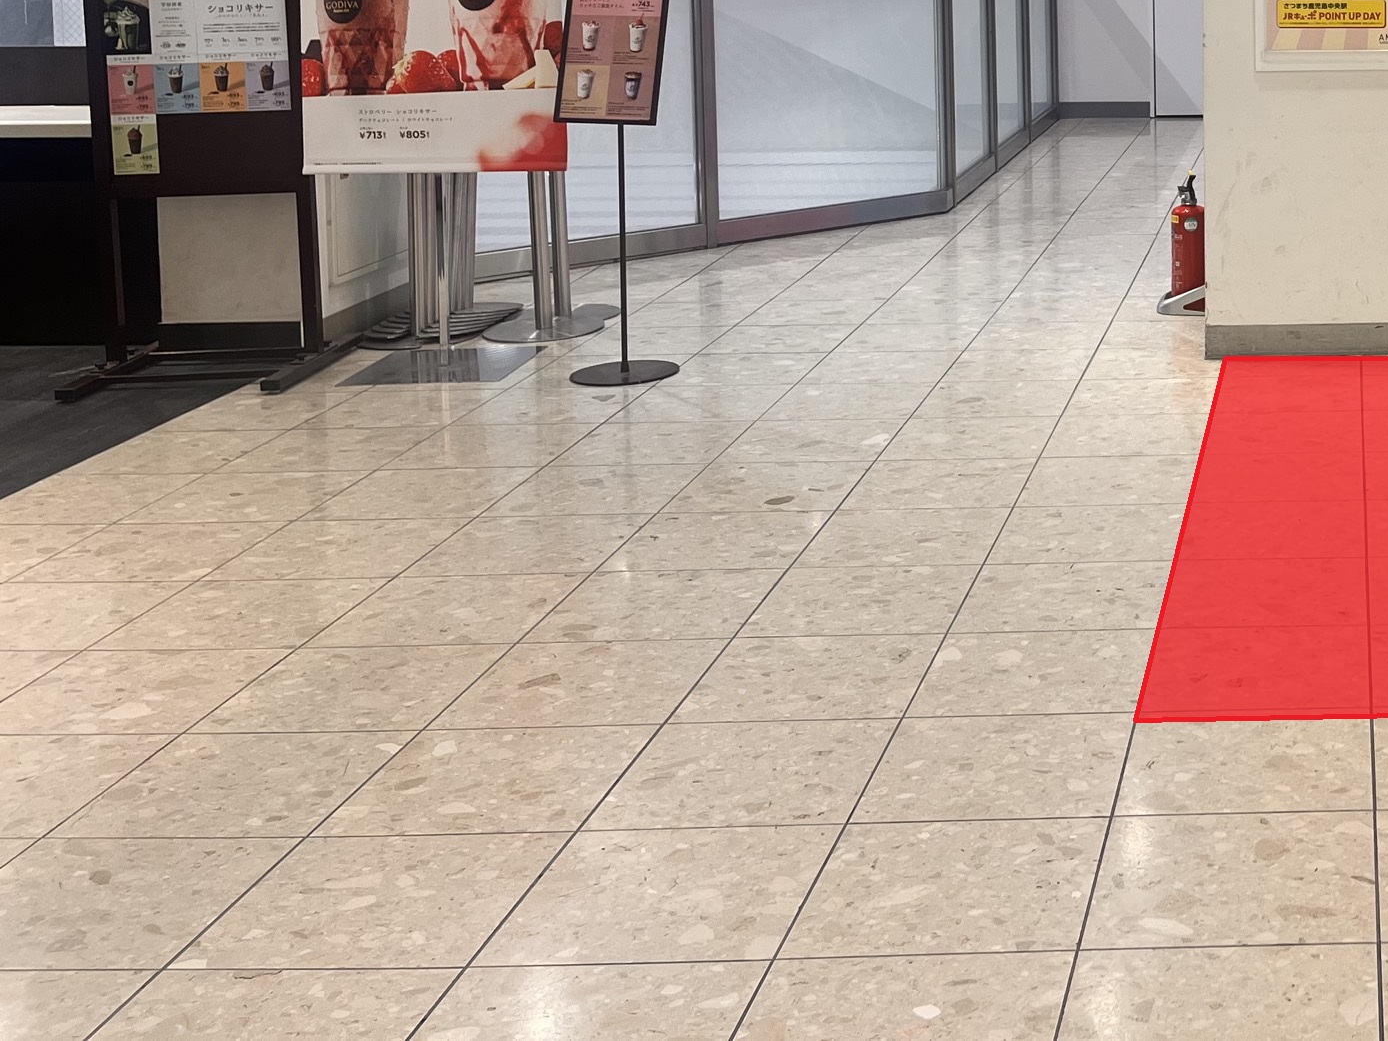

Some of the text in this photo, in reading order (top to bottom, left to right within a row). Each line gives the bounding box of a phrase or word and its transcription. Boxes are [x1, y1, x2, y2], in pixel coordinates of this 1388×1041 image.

[207, 3, 274, 14] ショコリキサー
[325, 1, 359, 10] GODIVA
[1318, 12, 1348, 21] POINT
[1348, 12, 1361, 21] UP
[1362, 12, 1382, 21] DAY
